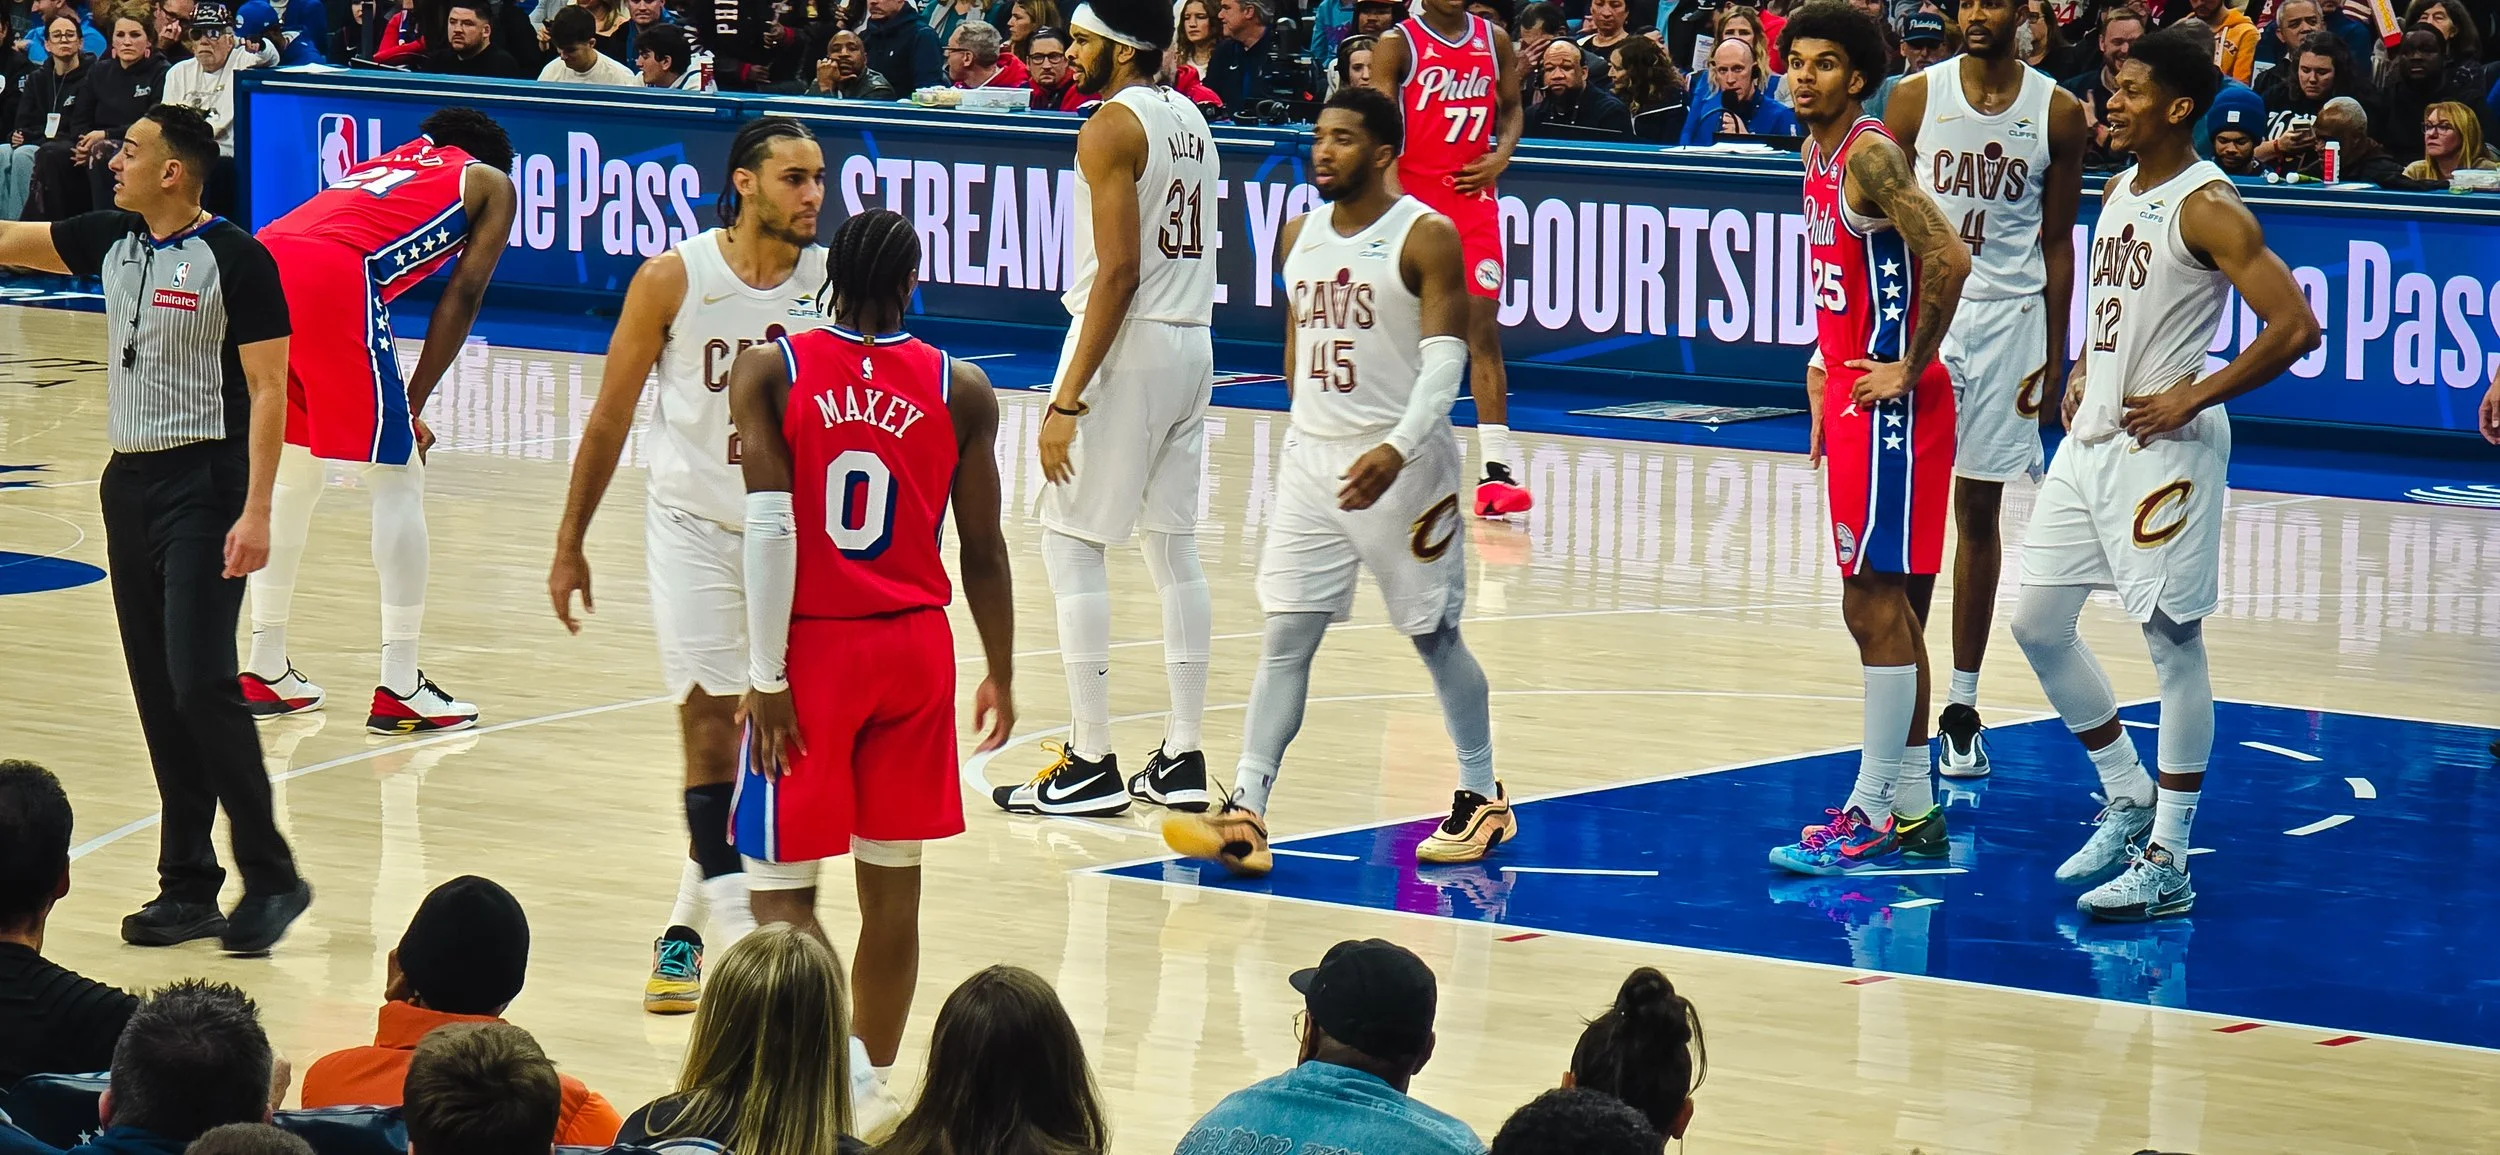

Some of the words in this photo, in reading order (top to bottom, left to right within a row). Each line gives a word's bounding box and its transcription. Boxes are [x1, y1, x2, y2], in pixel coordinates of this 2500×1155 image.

[1415, 65, 1492, 111] Phila
[1168, 131, 1205, 164] ALLEN
[1443, 106, 1488, 143] 77
[567, 130, 700, 258] Pass
[1934, 148, 2029, 202] CAVS
[1157, 178, 1204, 260] 31
[1804, 195, 1837, 247] Phila
[1959, 207, 1987, 257] 4
[1496, 195, 1819, 345] COURTSID
[1812, 258, 1848, 313] 25
[2092, 235, 2153, 292] CAVS
[154, 291, 197, 308] Emirates
[1293, 279, 1377, 330] CAVS
[2093, 297, 2123, 353] 12
[2345, 239, 2500, 389] Pas
[1307, 340, 1358, 394] 45
[813, 385, 925, 440] MAXEY
[824, 449, 898, 561] 0
